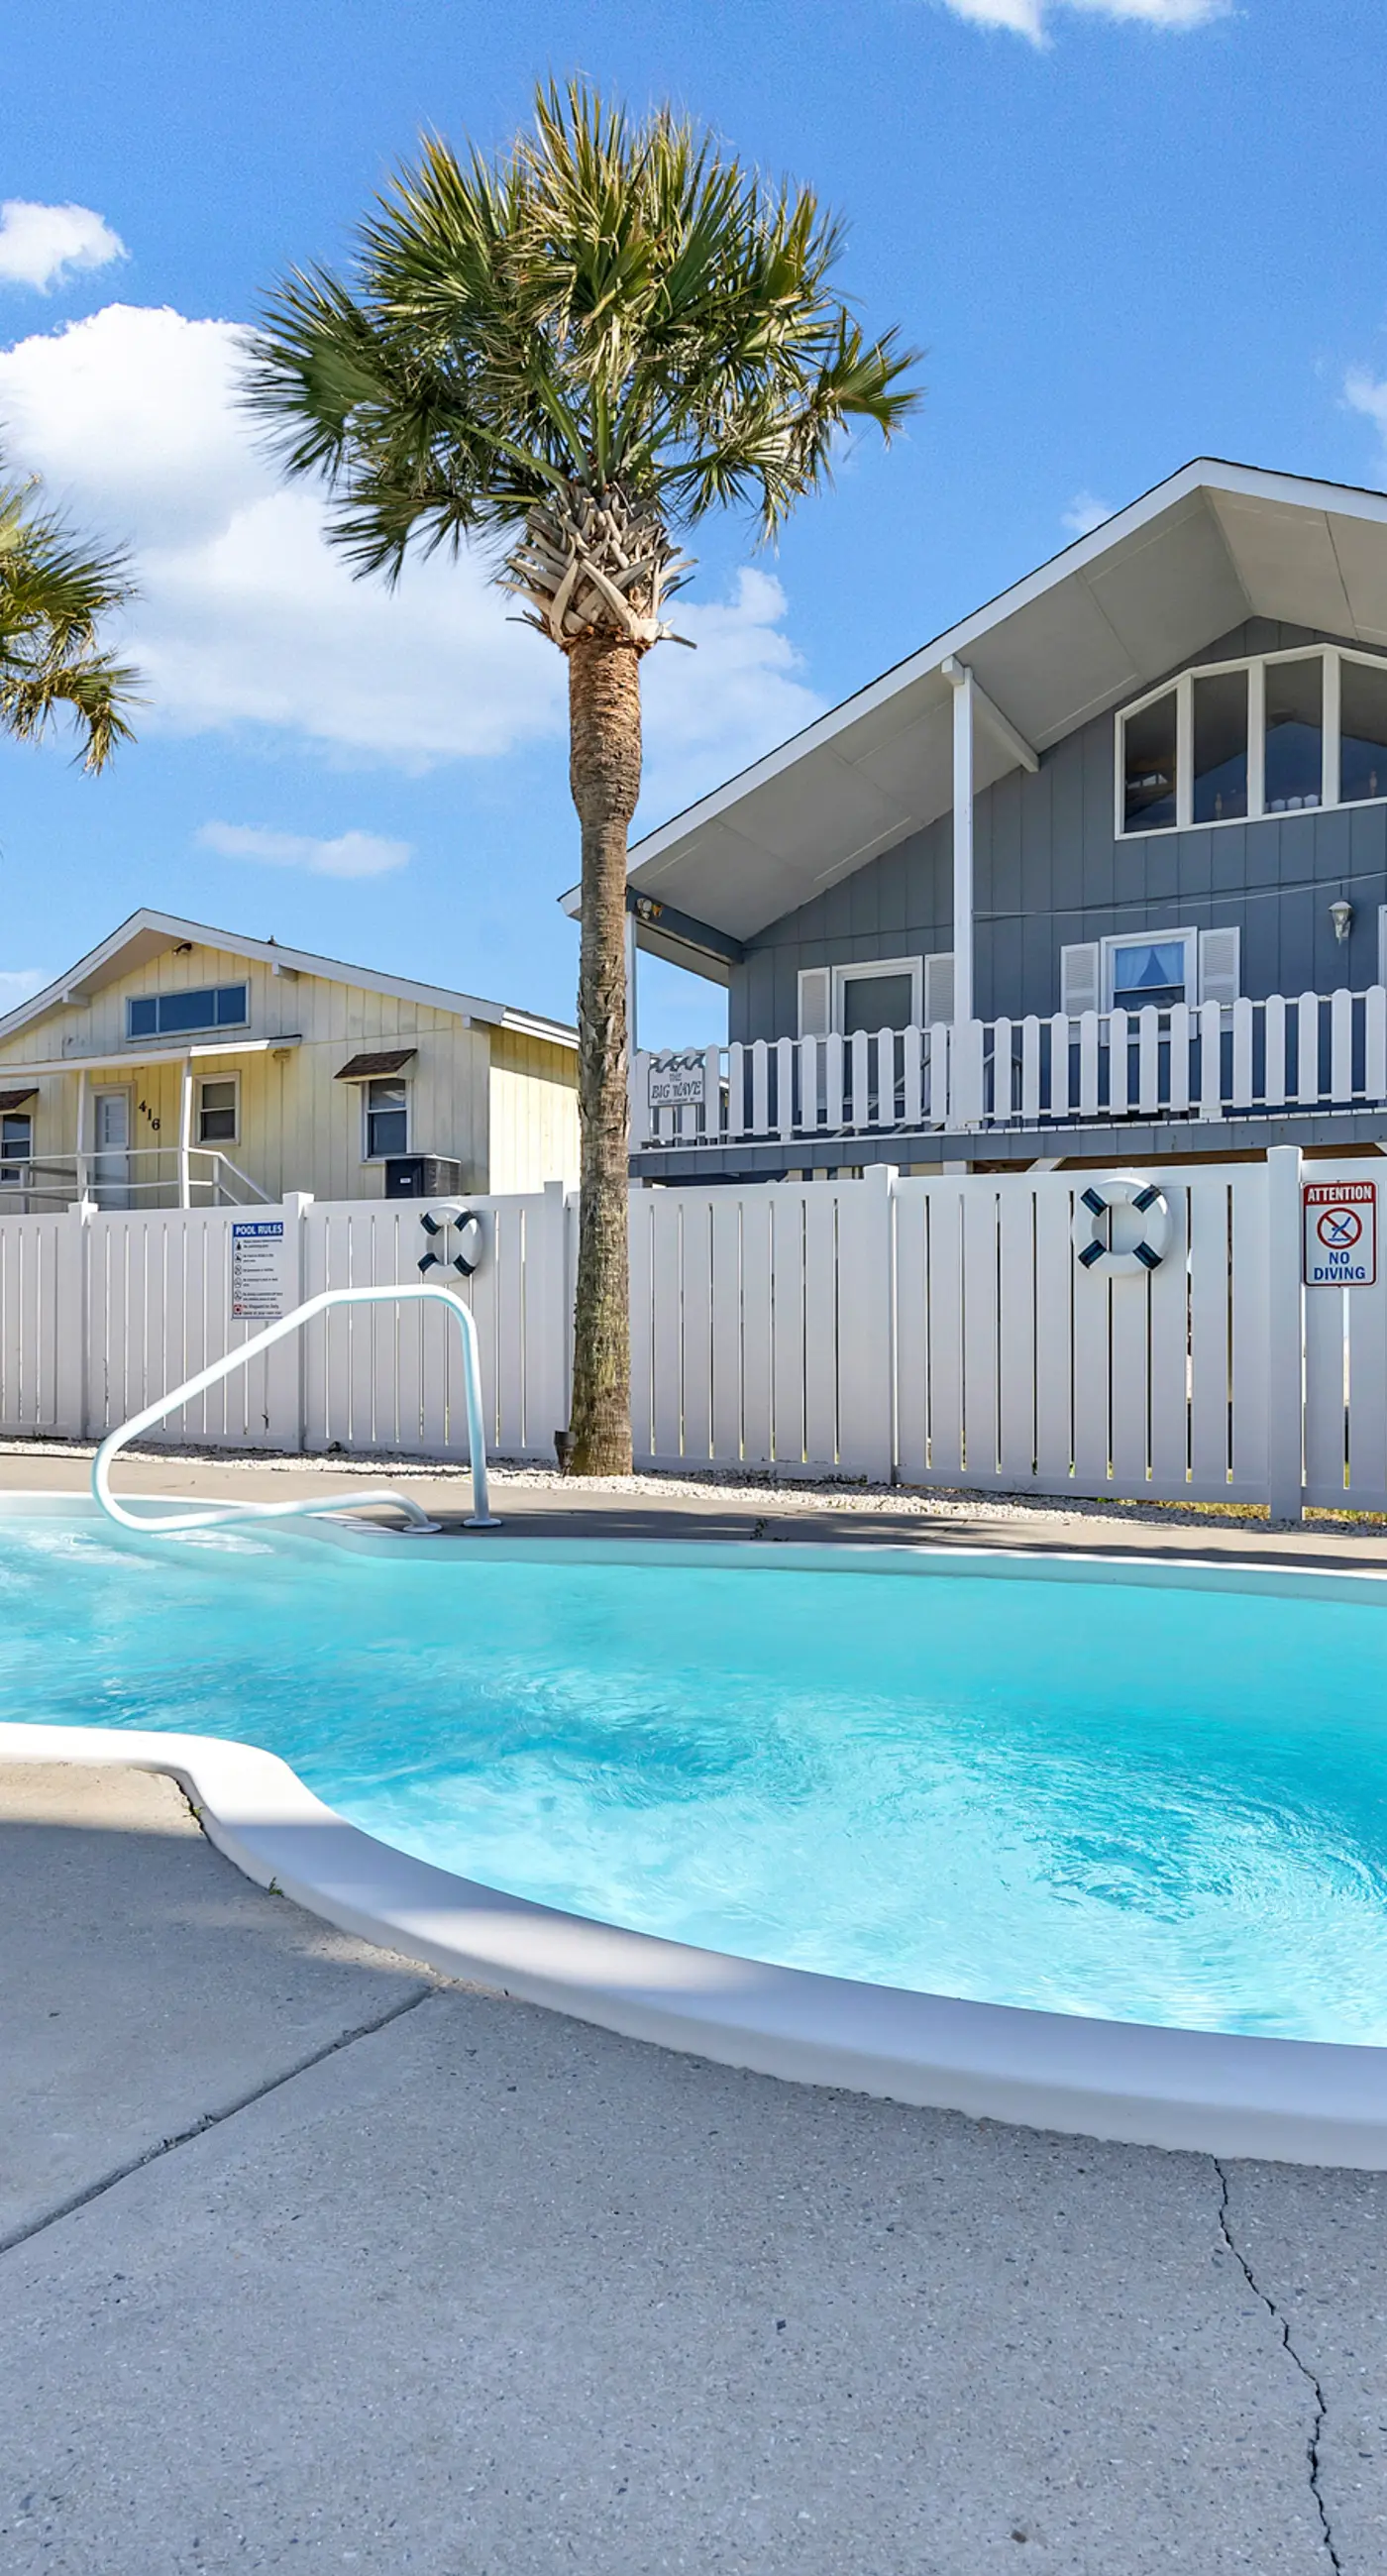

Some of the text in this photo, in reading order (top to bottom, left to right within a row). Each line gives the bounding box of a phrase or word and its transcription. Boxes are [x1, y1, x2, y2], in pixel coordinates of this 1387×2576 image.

[651, 1081, 701, 1099] BIG WAVE
[139, 1100, 160, 1130] 416
[1308, 1186, 1372, 1202] ATTENTION
[236, 1224, 282, 1235] POOL RULES
[1330, 1251, 1350, 1265] NO
[1314, 1266, 1366, 1280] DIVING
